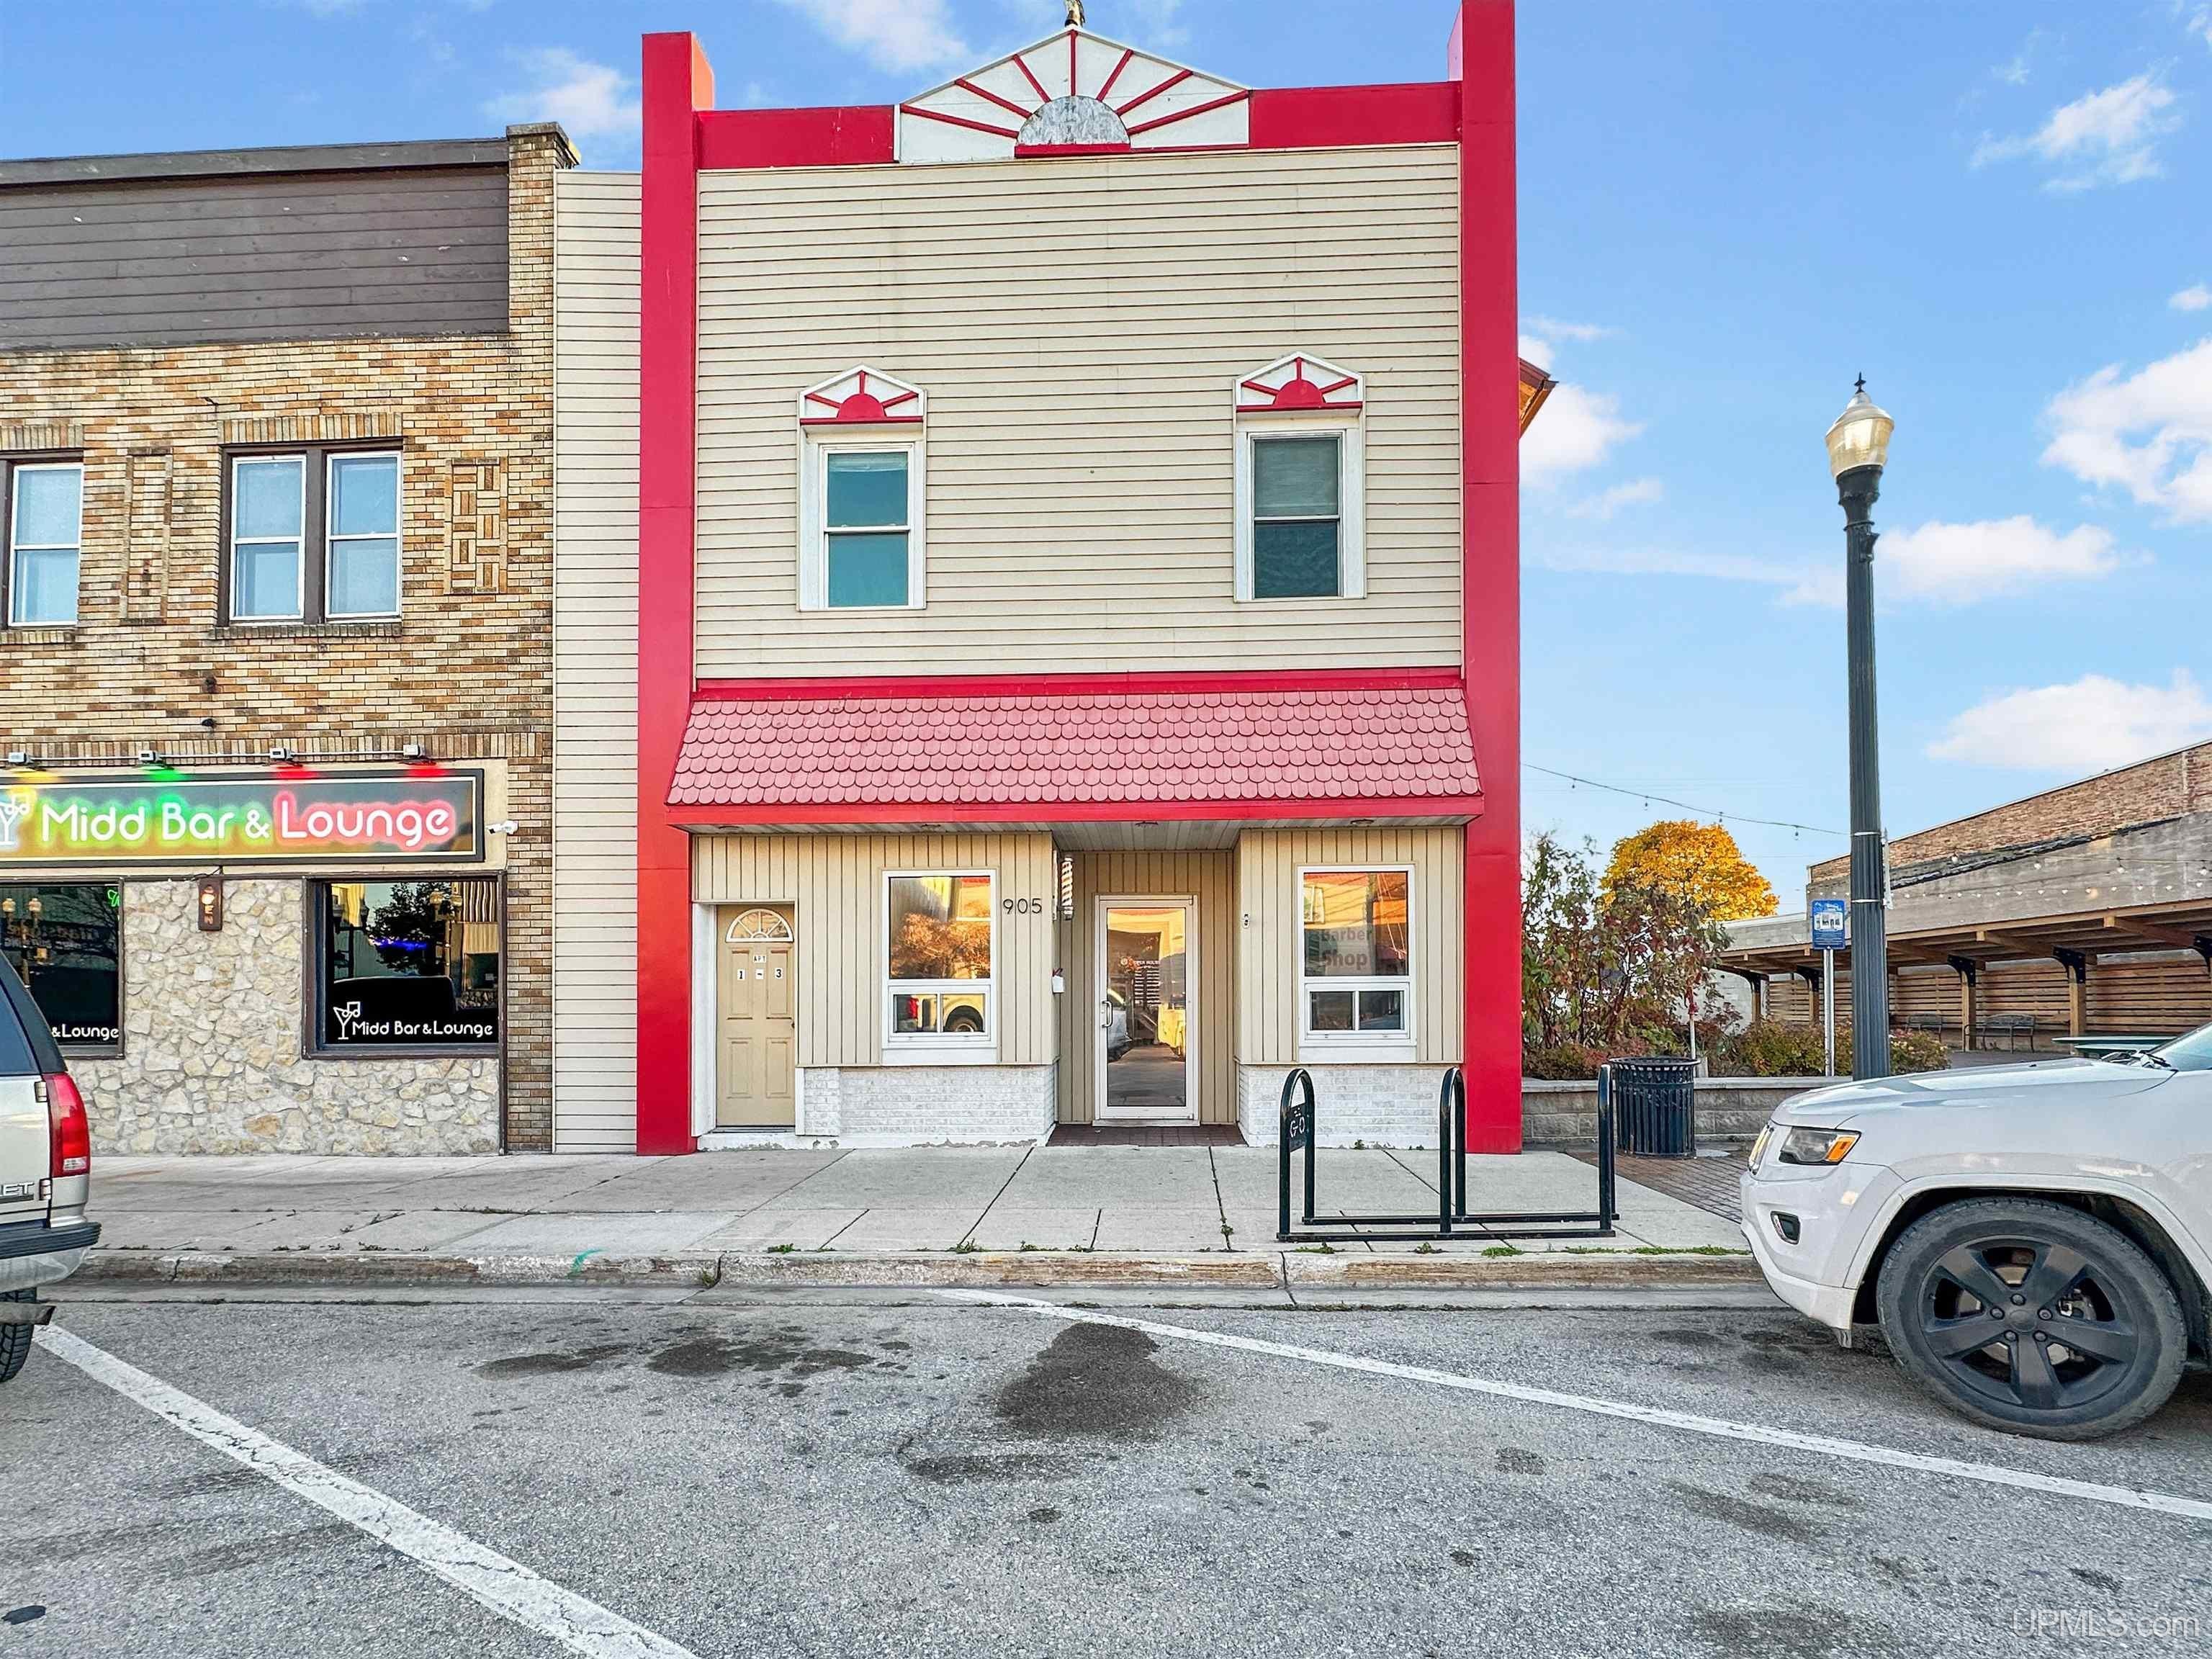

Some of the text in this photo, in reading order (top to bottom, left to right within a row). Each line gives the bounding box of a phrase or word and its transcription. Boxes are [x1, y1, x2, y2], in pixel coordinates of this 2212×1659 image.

[42, 799, 449, 848] Midd Bar & Lounge
[1003, 898, 1043, 914] 905
[776, 968, 782, 978] 3
[51, 1023, 119, 1040] & Lounge
[352, 1020, 493, 1038] Midd Bar & Lounge
